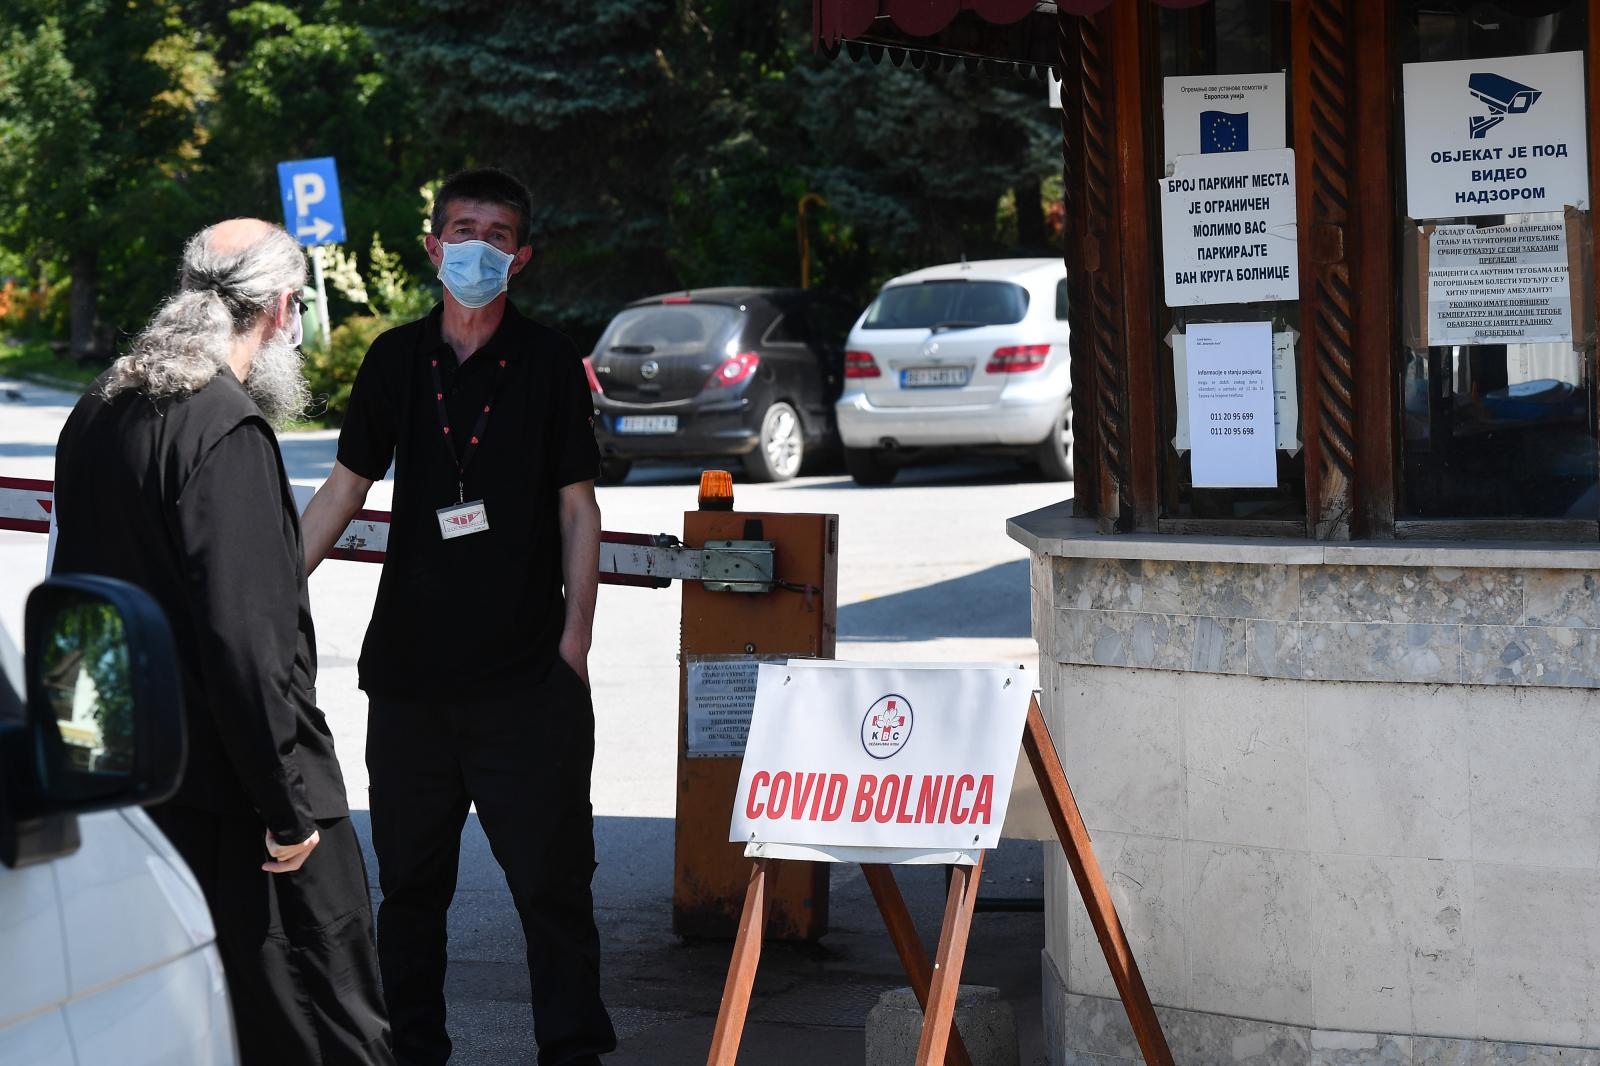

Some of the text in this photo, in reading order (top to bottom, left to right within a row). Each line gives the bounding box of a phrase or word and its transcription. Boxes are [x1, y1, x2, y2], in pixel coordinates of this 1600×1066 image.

[1430, 144, 1568, 164] ОБЈЕКАТ ЈЕ ПОД
[1168, 173, 1290, 192] БРОЈ ПАРКИНГ МЕСТА
[1471, 167, 1527, 182] ВИДЕО
[293, 172, 326, 217] P
[1455, 187, 1545, 204] НАДЗОРОМ
[1188, 198, 1270, 214] ЈЕ ОГРАНИЧЕН
[1193, 221, 1266, 238] МОЛИМО ВАС
[1198, 244, 1268, 260] ПАРКИРАЈТЕ
[1176, 266, 1290, 284] ВАН КРУГА БОЛНИЦЕ
[1484, 300, 1508, 308] ИМАТЕ
[1210, 413, 1222, 421] 011
[1233, 412, 1241, 420] 95
[1242, 412, 1254, 420] 699
[1210, 428, 1222, 436] 011
[1242, 427, 1254, 435] 698
[746, 770, 995, 825] COVID BOLNICA
